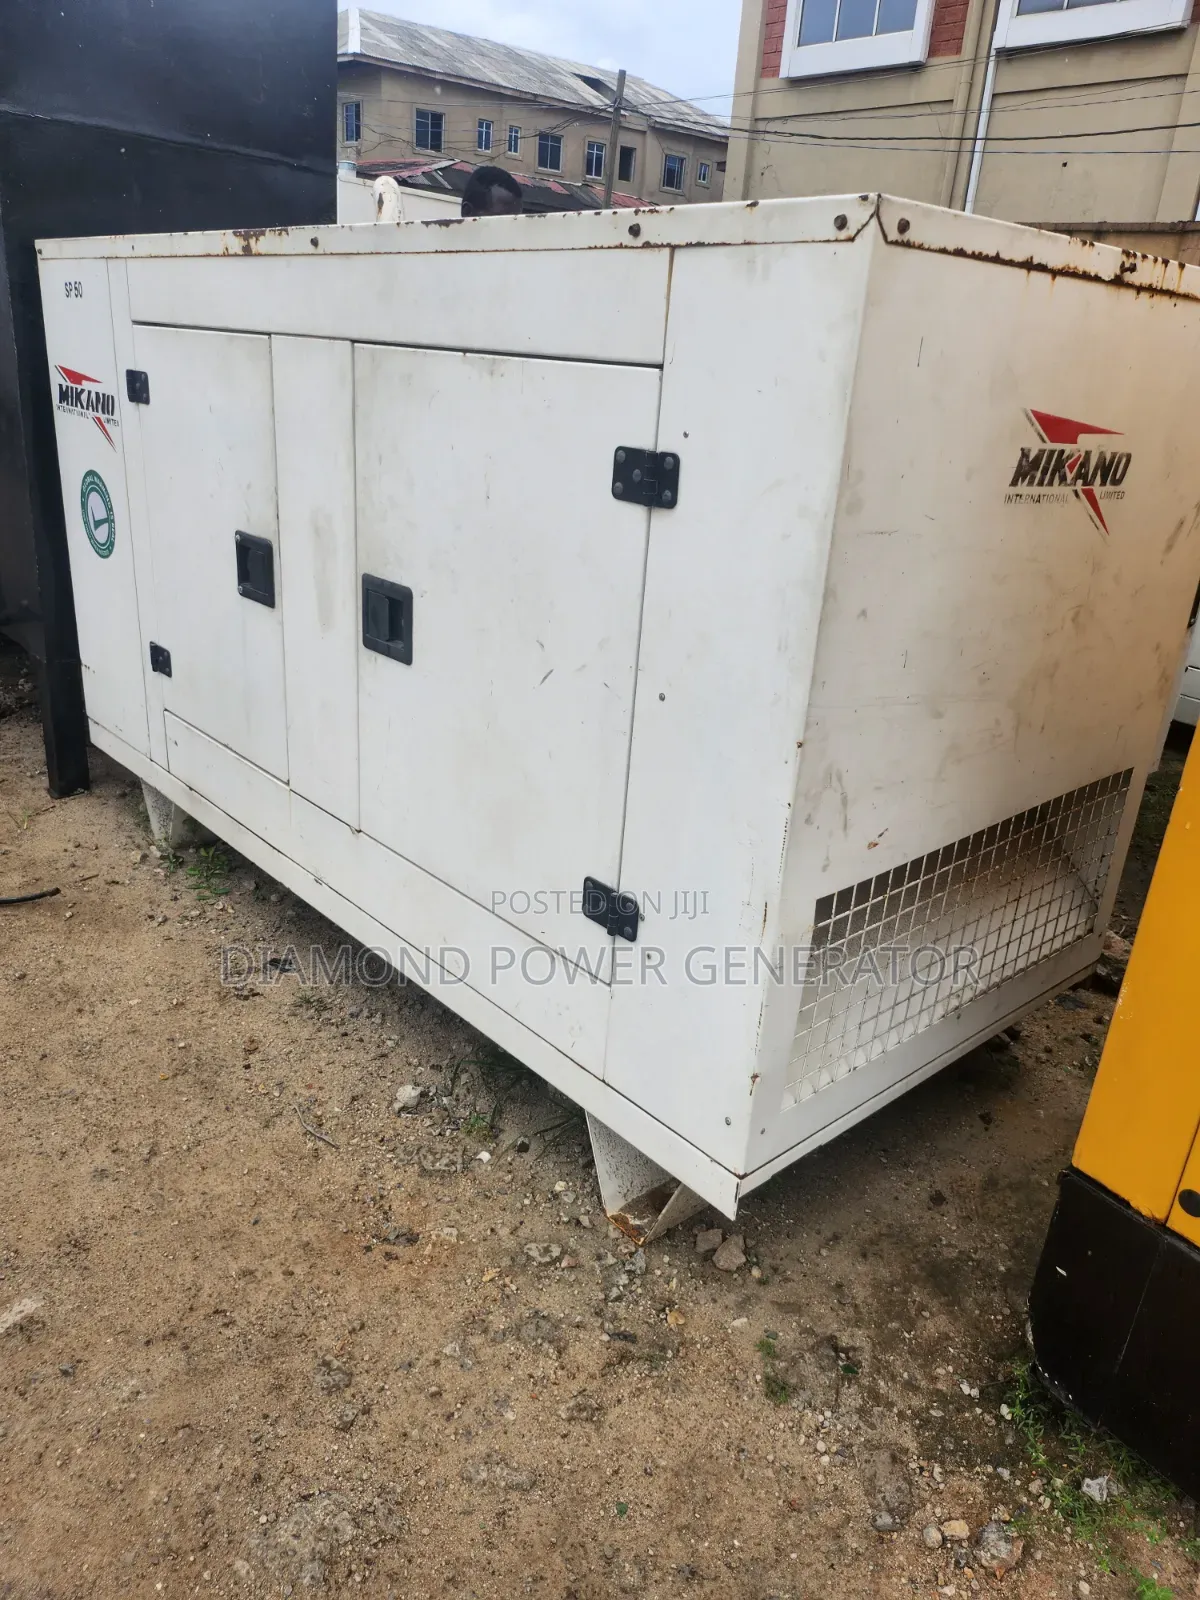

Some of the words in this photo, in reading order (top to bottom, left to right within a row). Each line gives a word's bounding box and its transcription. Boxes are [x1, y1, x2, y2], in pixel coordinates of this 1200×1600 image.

[64, 281, 73, 298] SP
[74, 281, 82, 298] 50
[58, 383, 115, 416] MIKANO
[1009, 447, 1132, 487] MIKANO
